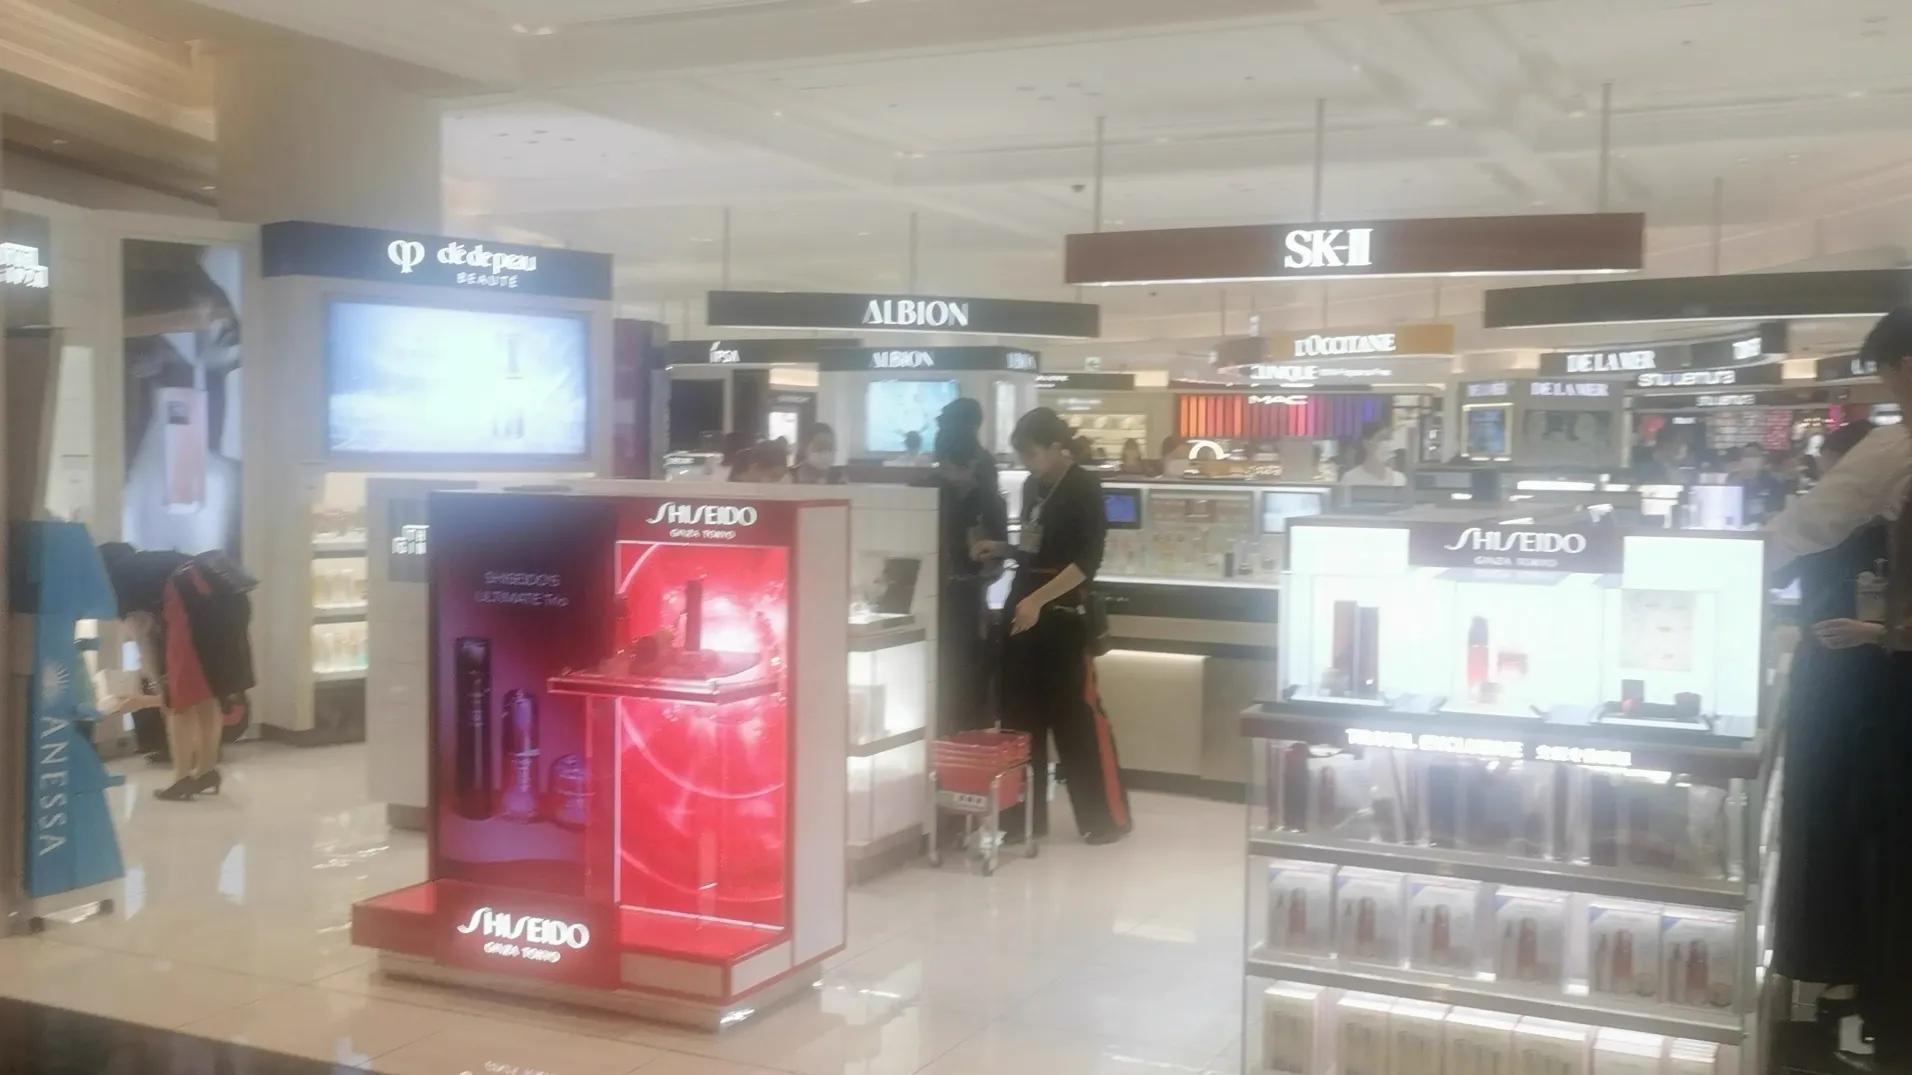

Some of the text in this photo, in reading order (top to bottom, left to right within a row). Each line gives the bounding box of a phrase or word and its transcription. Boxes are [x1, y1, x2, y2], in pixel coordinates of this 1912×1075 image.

[1284, 228, 1374, 268] SK-II
[862, 299, 969, 327] ALBION
[870, 350, 936, 368] ALBION
[645, 501, 758, 527] SHISEIDO
[1444, 527, 1587, 554] SHISEIDO
[37, 715, 71, 857] ANESSA
[457, 907, 591, 949] SHISEIDO
